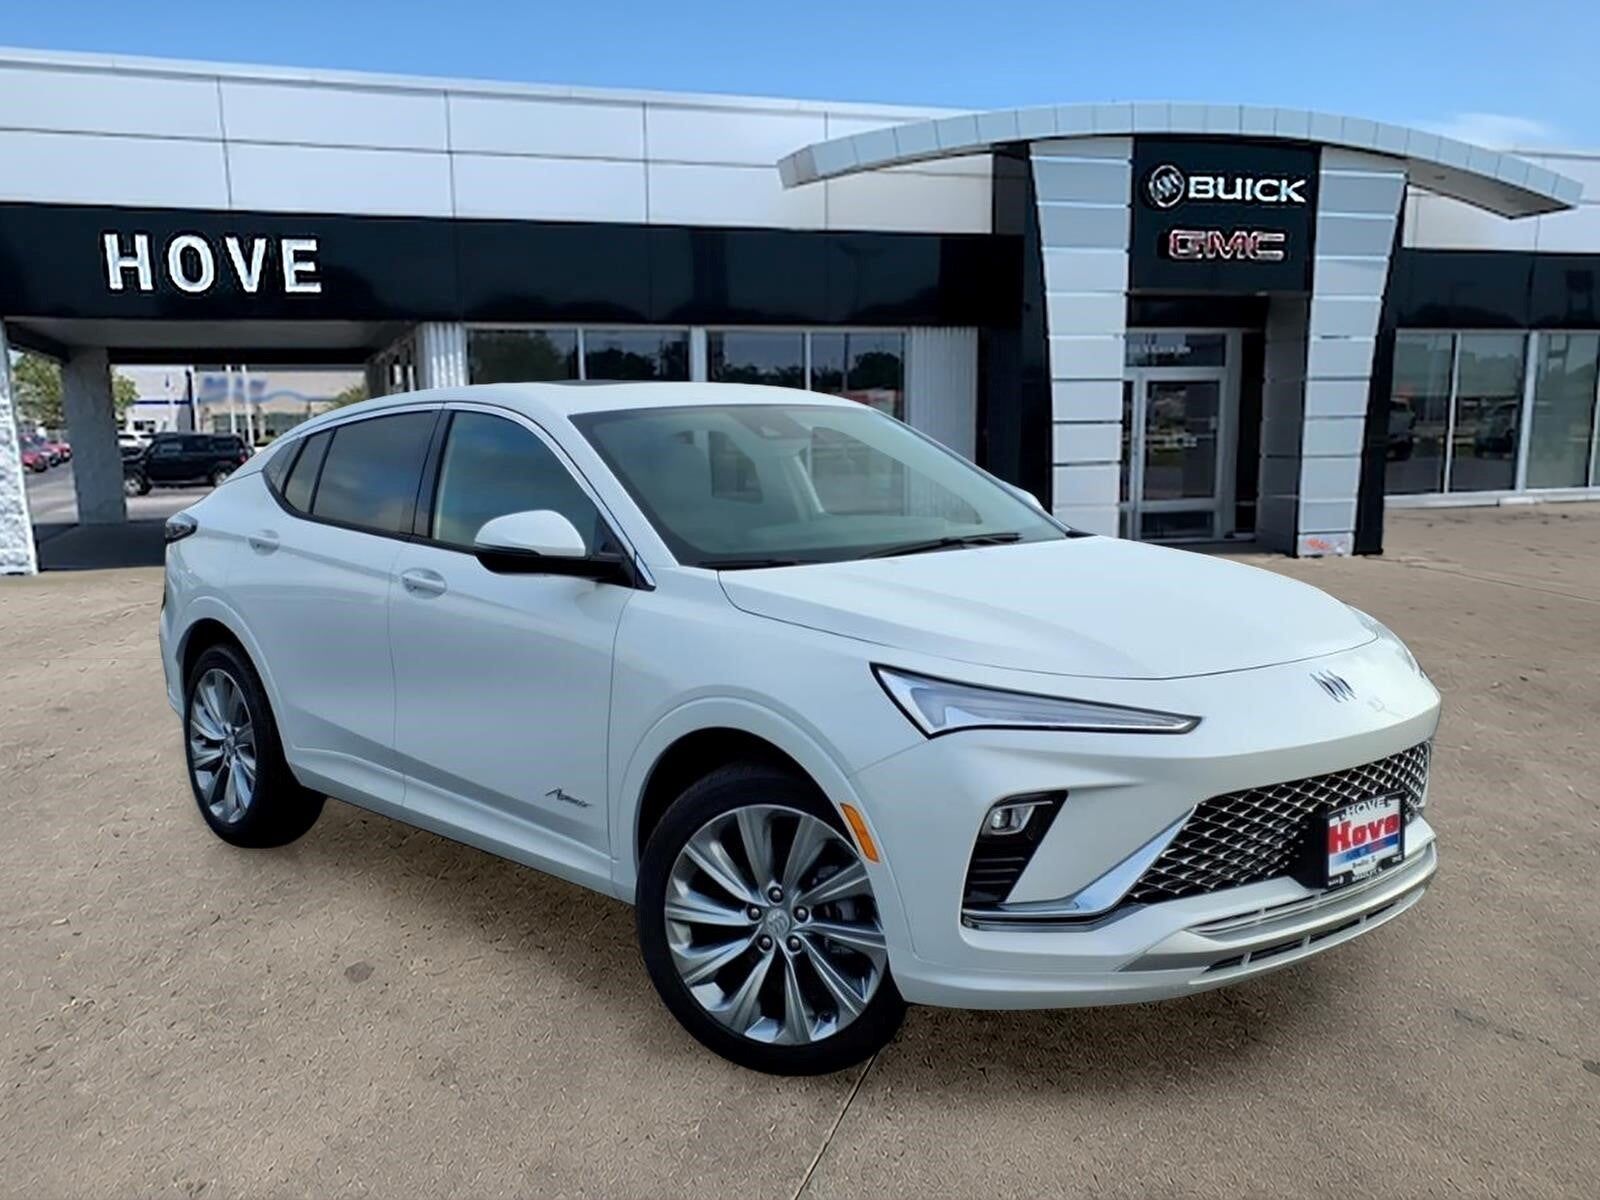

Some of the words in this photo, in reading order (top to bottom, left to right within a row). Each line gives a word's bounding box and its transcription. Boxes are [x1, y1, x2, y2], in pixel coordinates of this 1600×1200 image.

[1188, 176, 1306, 202] BUICK
[1169, 229, 1285, 260] GMC
[104, 234, 321, 292] HOVE
